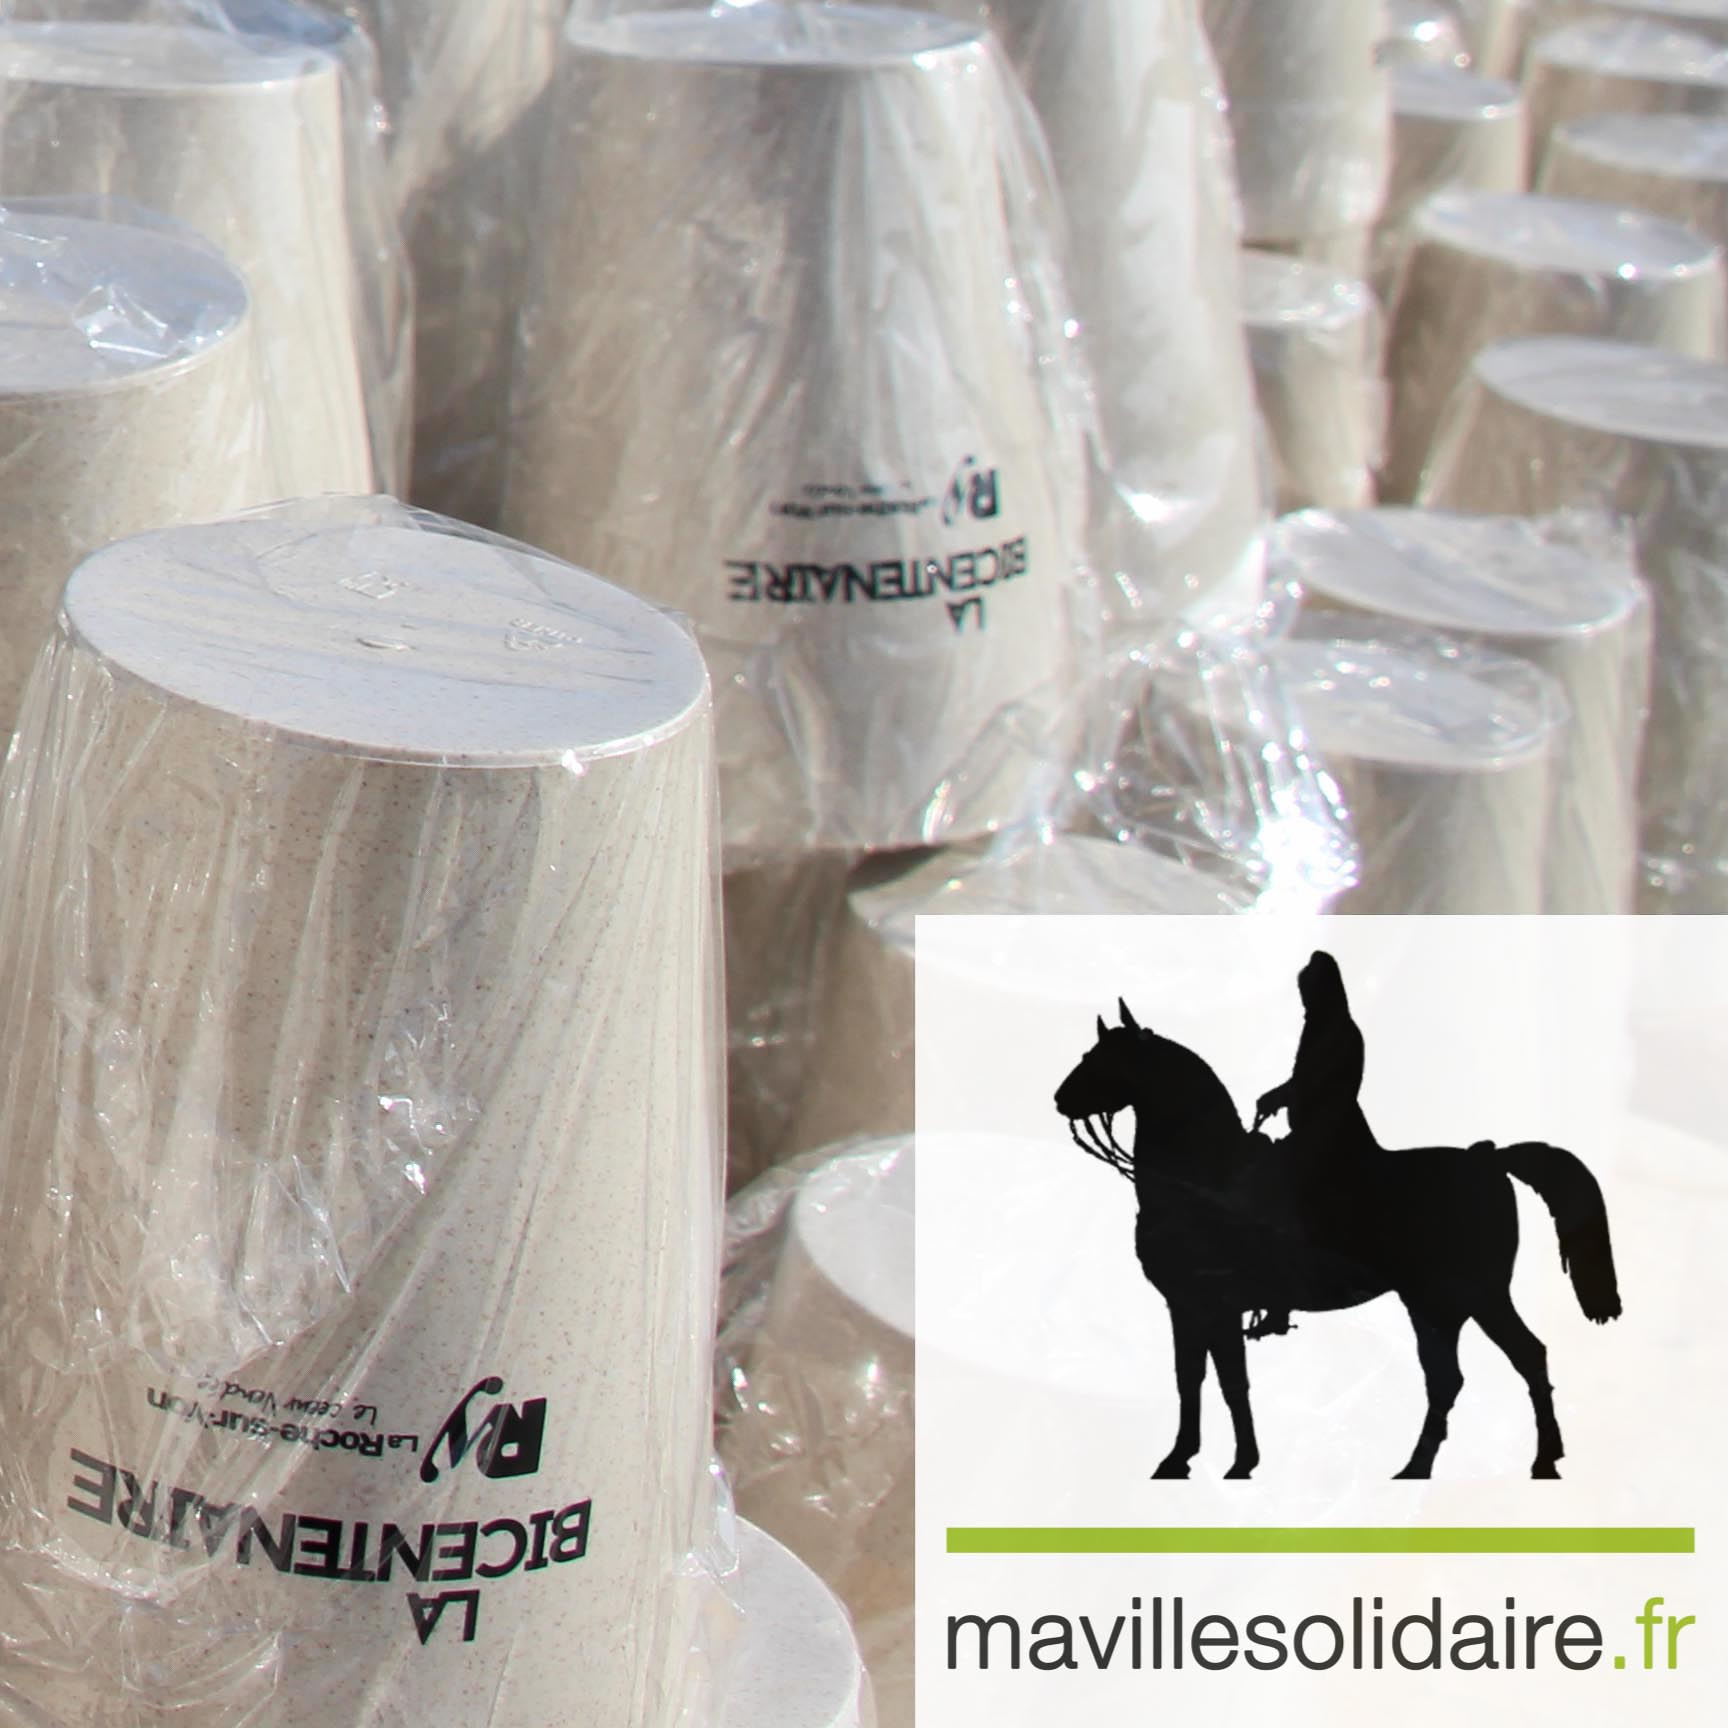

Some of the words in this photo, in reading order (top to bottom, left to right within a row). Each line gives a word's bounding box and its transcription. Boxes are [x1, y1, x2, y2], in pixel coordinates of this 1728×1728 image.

[724, 536, 1028, 604] BICENTENAIRE
[946, 597, 985, 633] LA
[67, 1447, 593, 1583] BICENTENAIRE
[406, 1588, 481, 1646] LA
